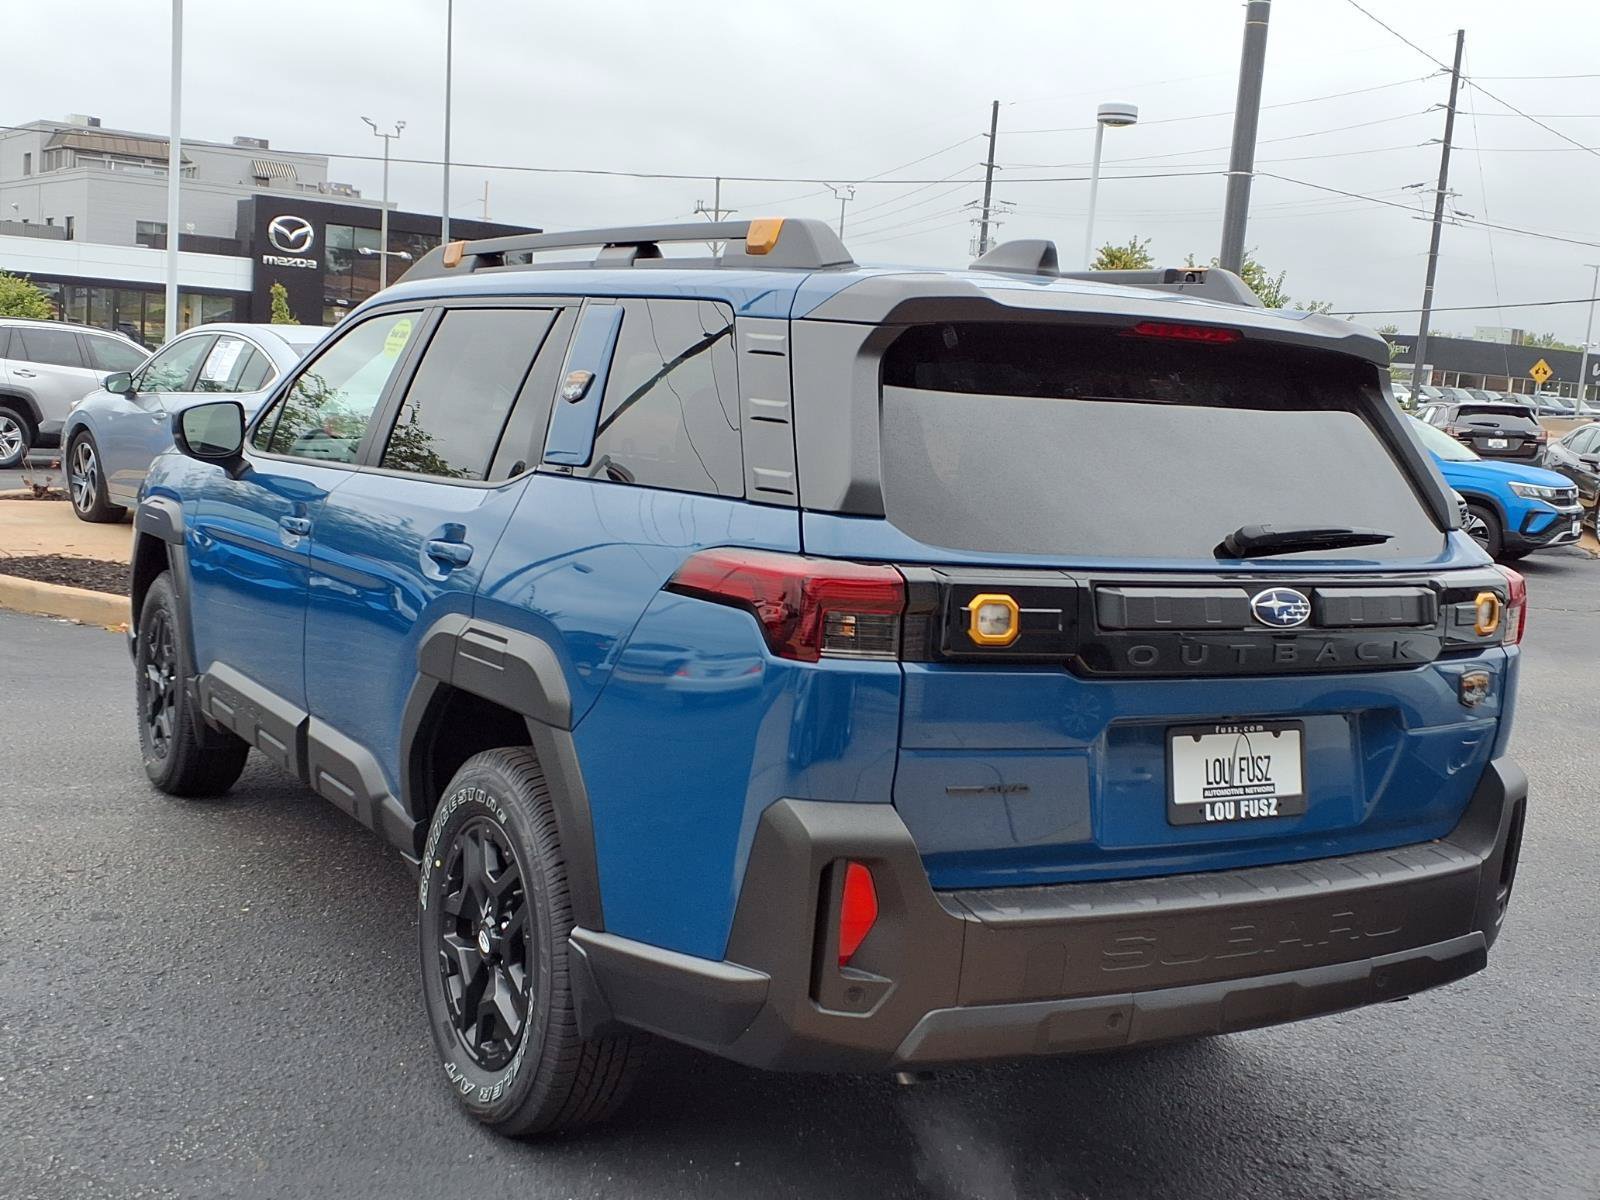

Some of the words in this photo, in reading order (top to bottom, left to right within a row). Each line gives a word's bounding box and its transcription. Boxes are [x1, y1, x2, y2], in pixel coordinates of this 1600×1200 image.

[1127, 640, 1411, 667] OUTBACK
[1215, 725, 1264, 734] fusz.com
[1205, 757, 1231, 785] LOU
[1239, 755, 1272, 783] FUSZ
[1204, 787, 1244, 797] AUTOMOTIVE
[1245, 785, 1275, 795] NETWORK
[1205, 801, 1235, 821] LOU
[1240, 798, 1278, 818] FUSZ
[1102, 908, 1402, 971] SUBARU
[444, 1062, 476, 1095] A/T
